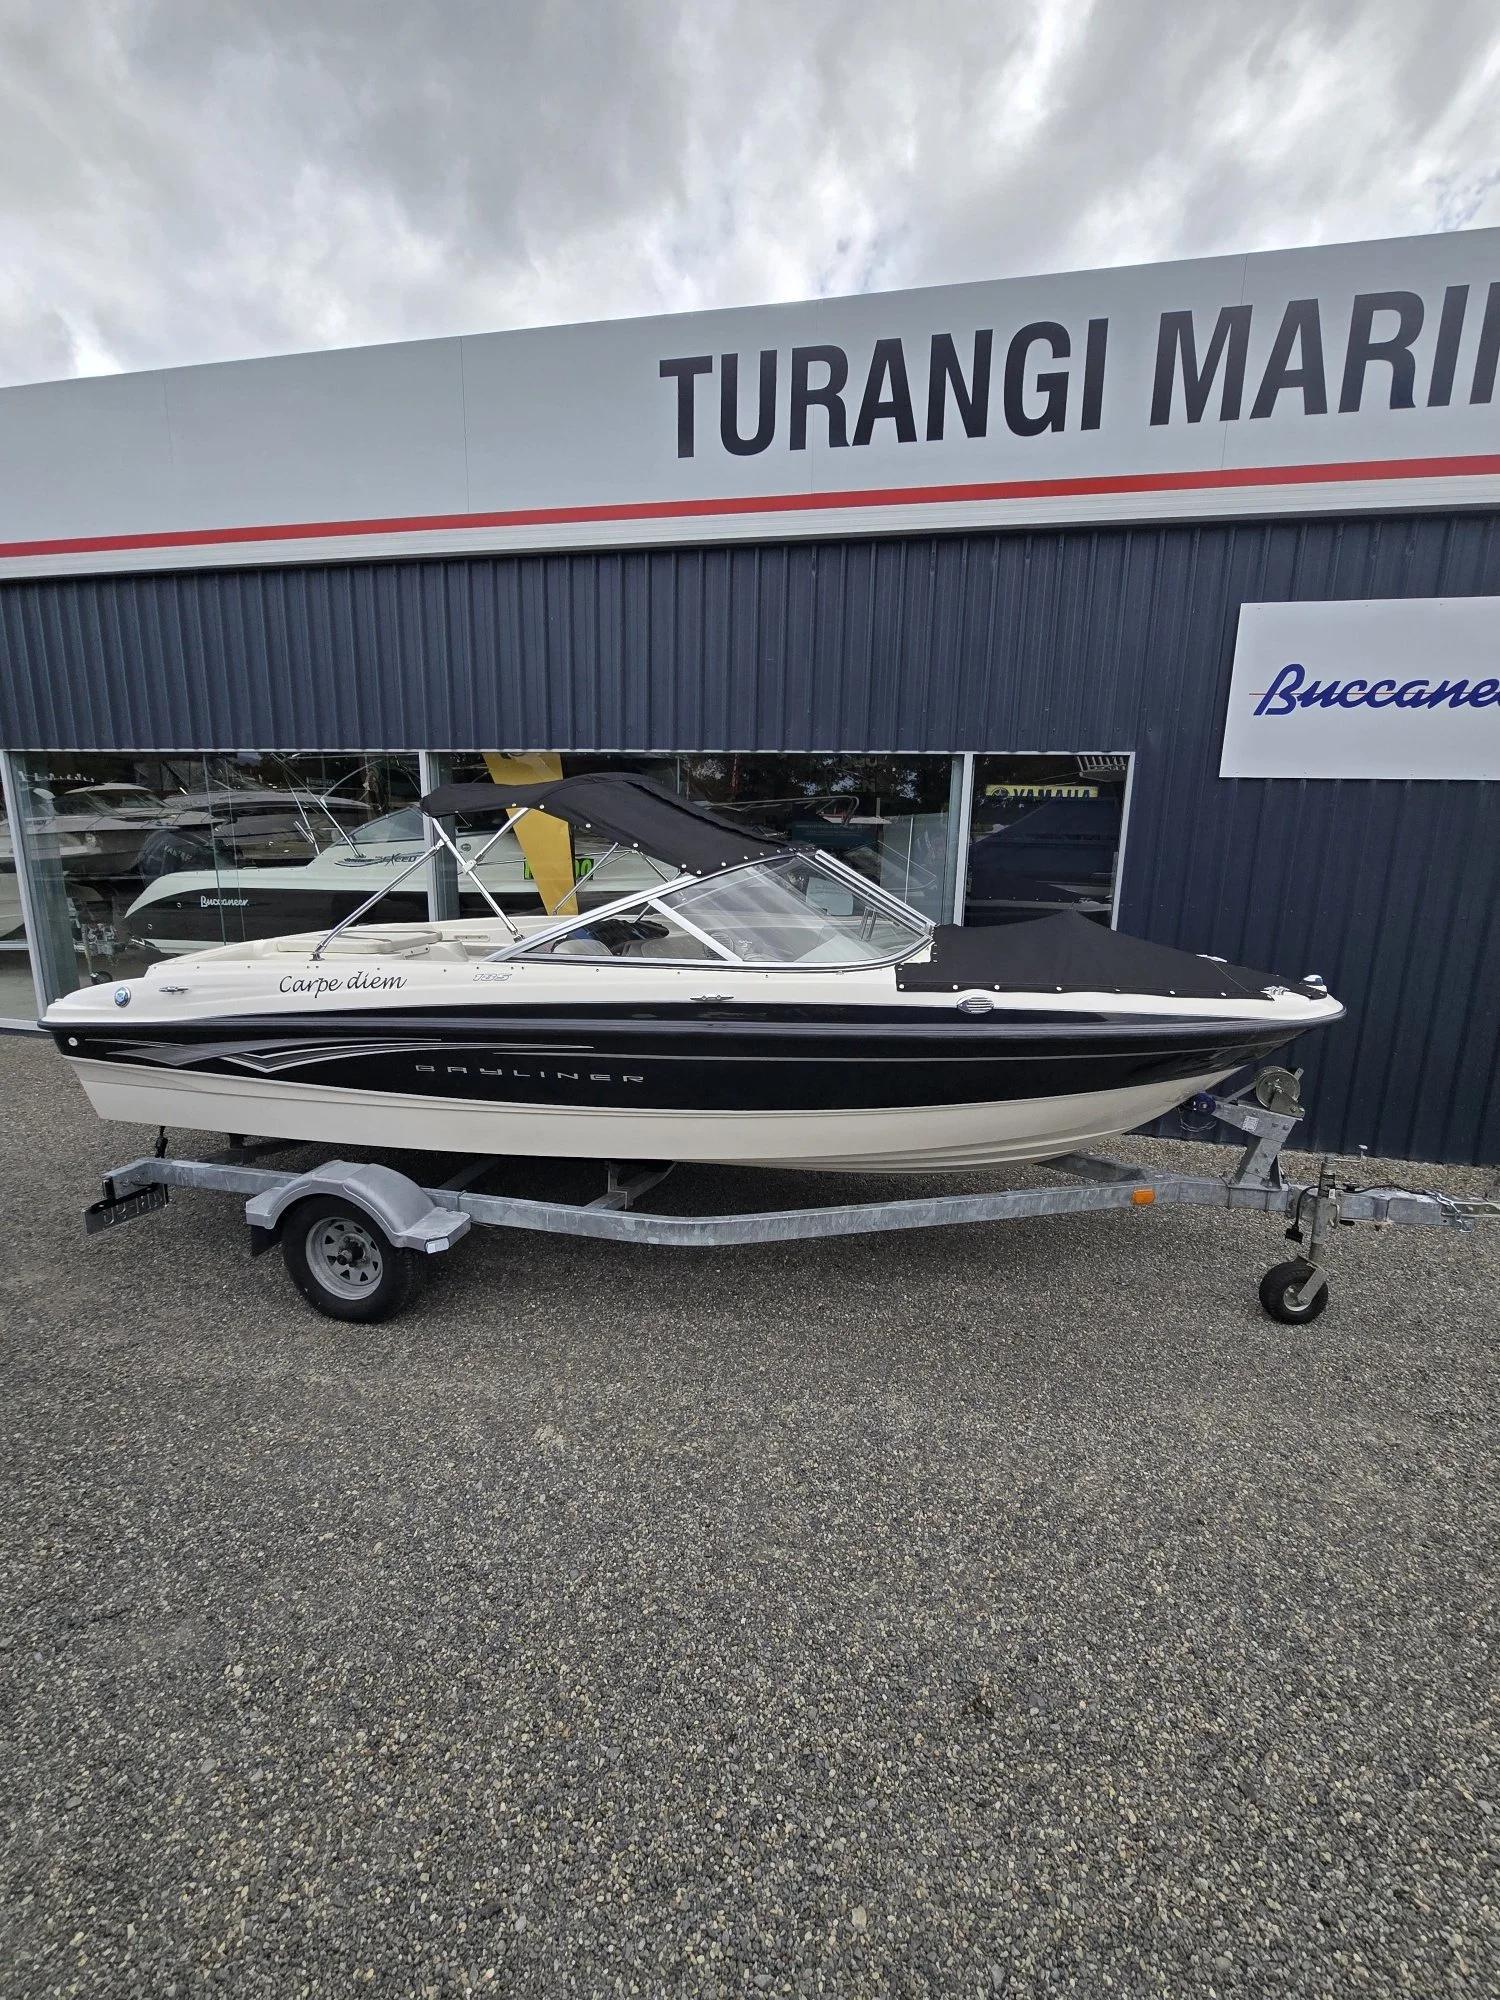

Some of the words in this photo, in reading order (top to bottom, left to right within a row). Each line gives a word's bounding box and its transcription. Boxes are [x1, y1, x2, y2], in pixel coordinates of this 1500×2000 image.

[659, 317, 1109, 460] TURANGI
[1253, 662, 1500, 716] Buccane
[200, 895, 249, 908] Buccaneer
[279, 975, 344, 999] Carpe
[346, 970, 408, 991] diem
[415, 1063, 645, 1084] BAYLINER
